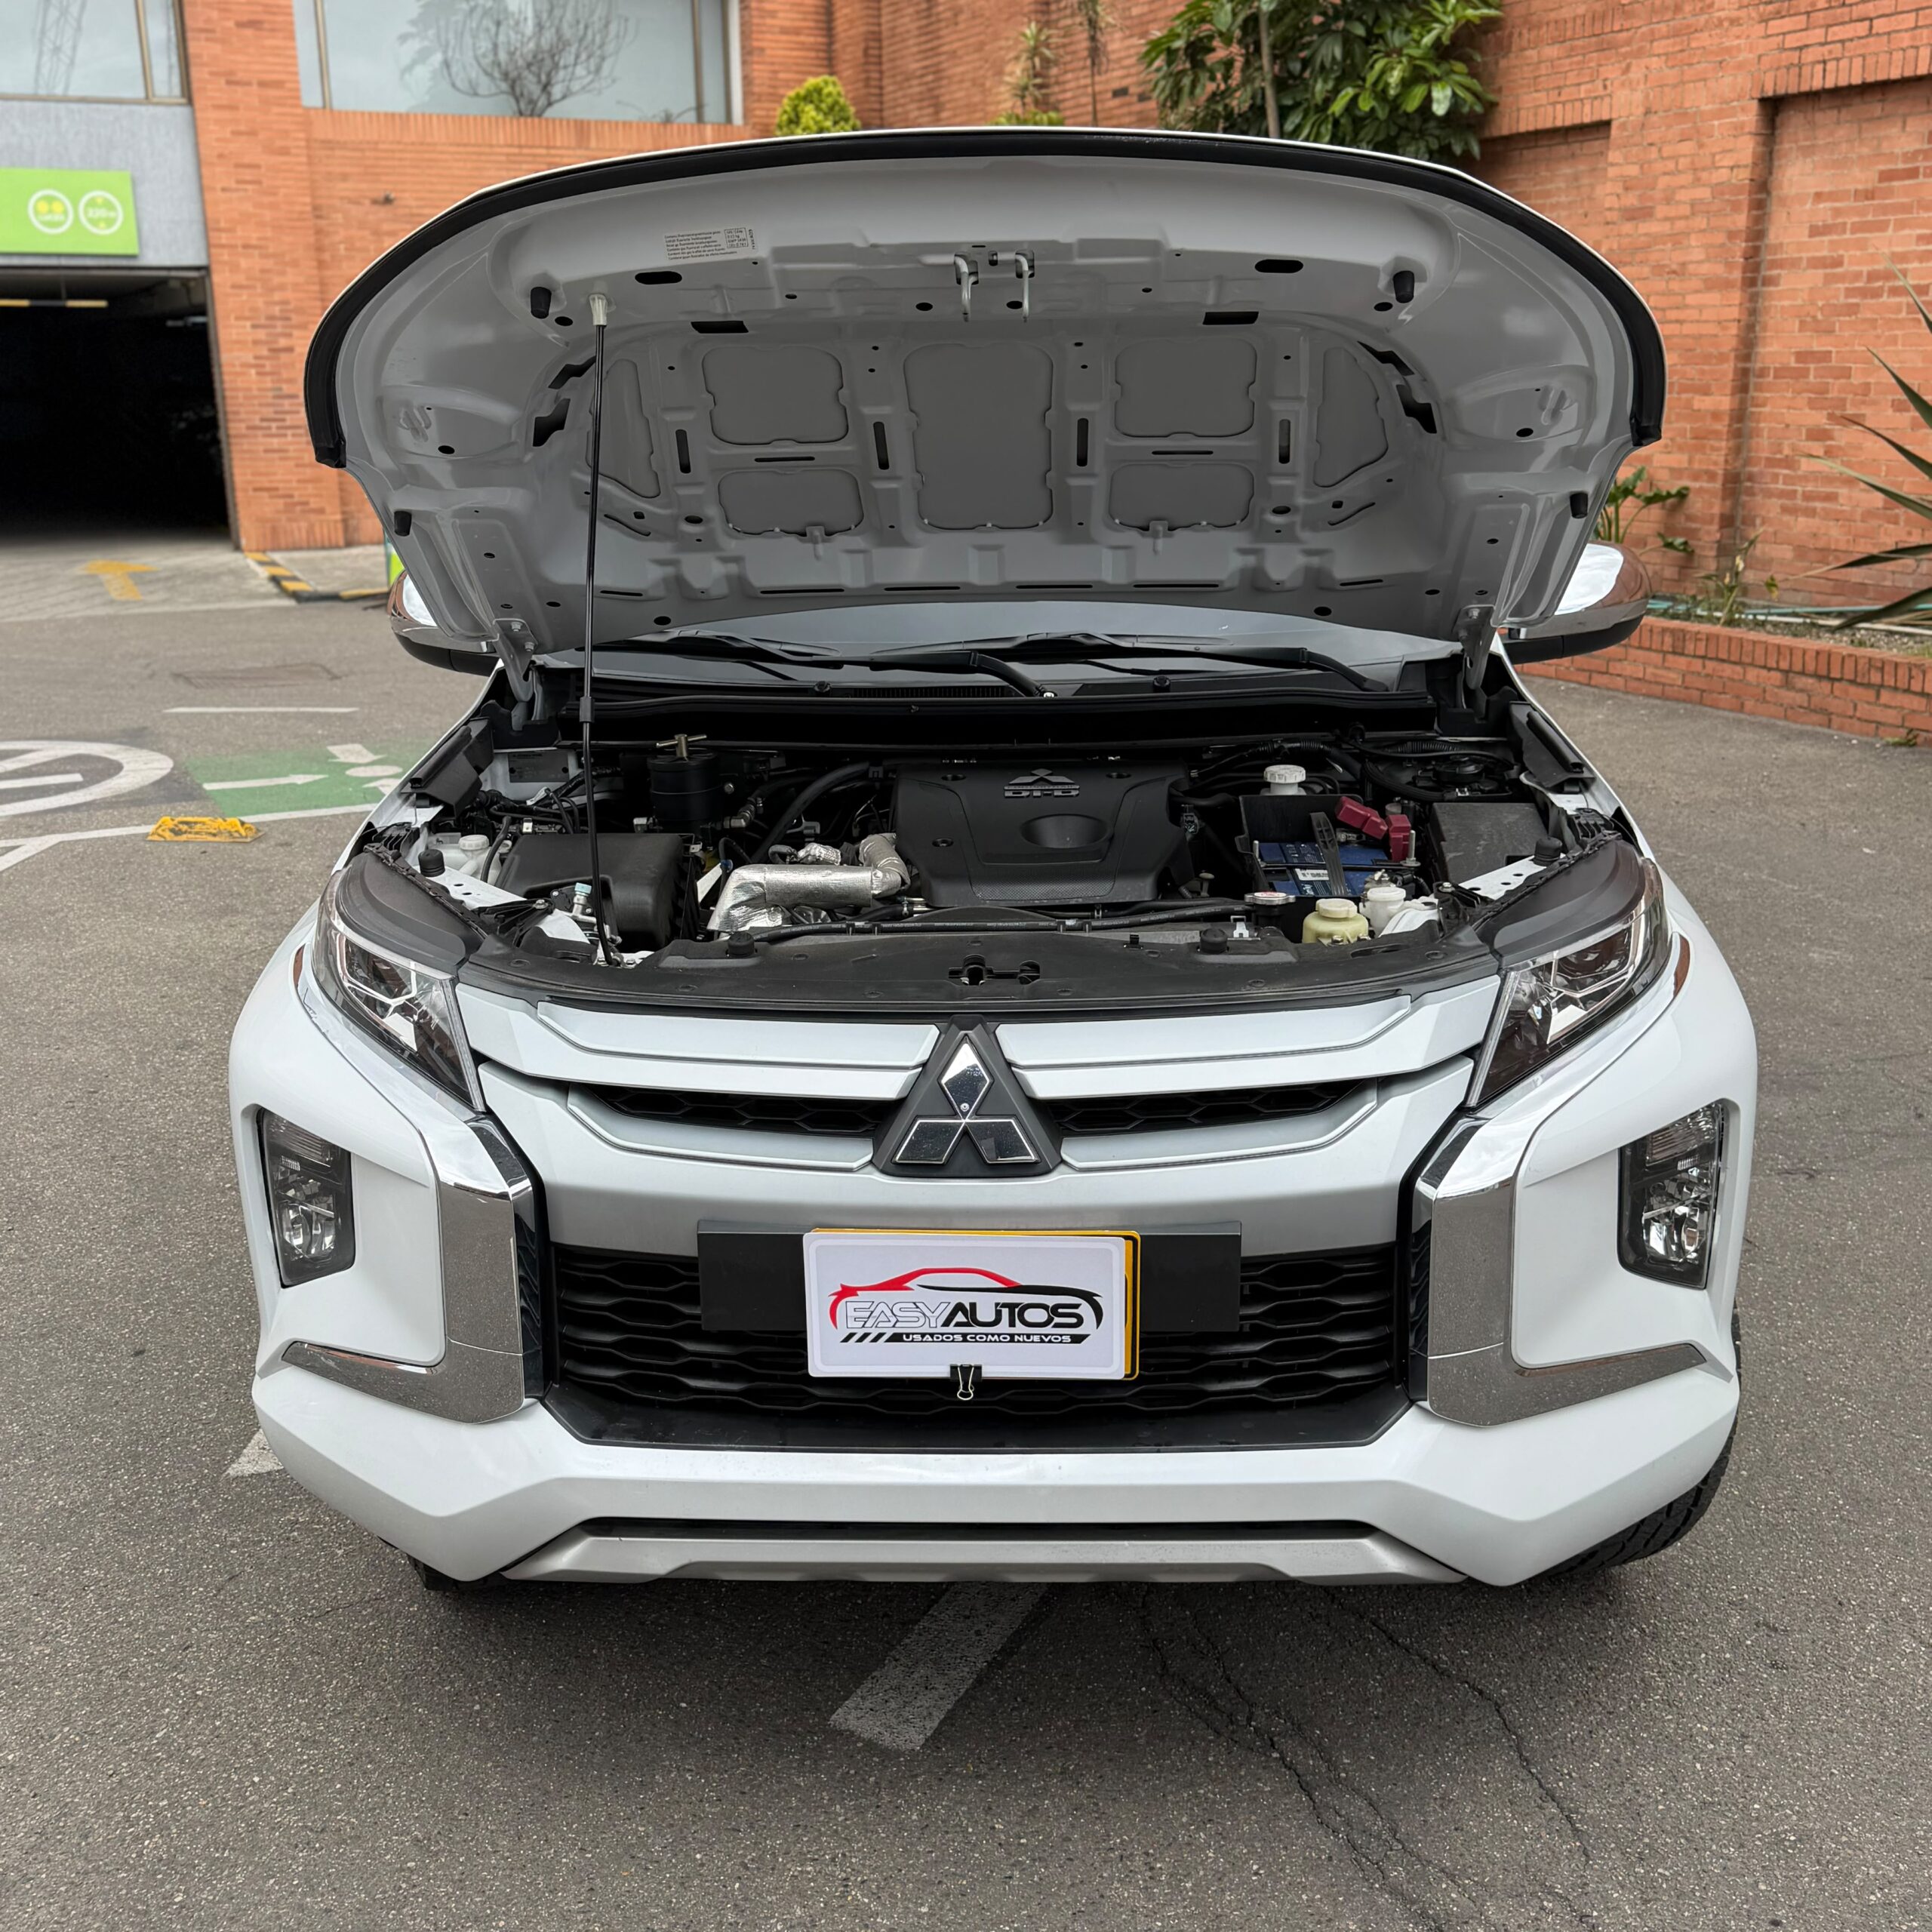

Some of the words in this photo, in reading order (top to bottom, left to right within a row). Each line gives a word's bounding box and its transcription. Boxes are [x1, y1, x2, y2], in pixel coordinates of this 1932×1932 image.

[903, 1334, 963, 1343] USADOS
[966, 1334, 1011, 1343] COMO
[1014, 1334, 1072, 1343] NUEVOS
